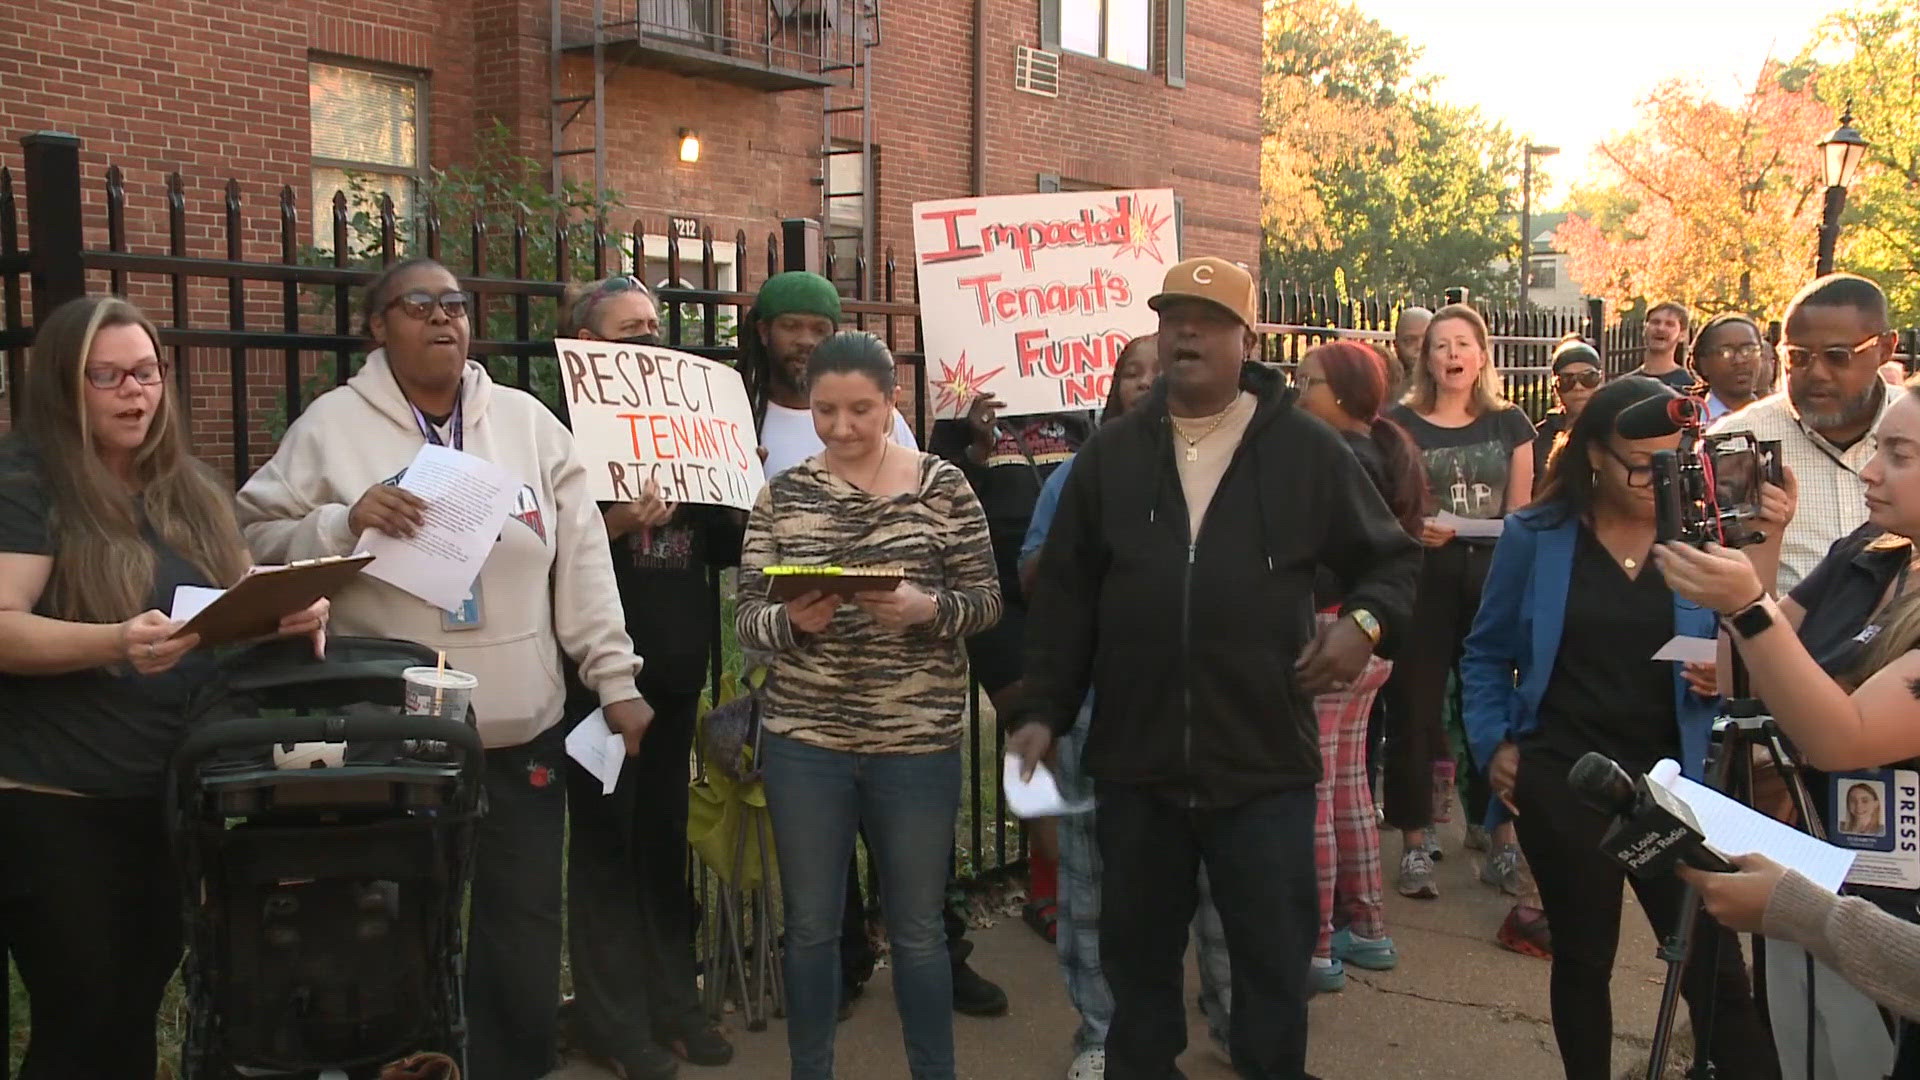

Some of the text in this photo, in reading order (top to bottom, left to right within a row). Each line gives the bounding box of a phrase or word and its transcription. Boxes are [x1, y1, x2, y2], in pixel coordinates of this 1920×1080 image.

[673, 218, 697, 236] 7212
[920, 196, 1132, 272] Impacted
[1192, 265, 1214, 285] C
[1015, 328, 1131, 378] FUND
[563, 350, 715, 414] RESPECT
[1060, 373, 1113, 407] NO
[616, 413, 748, 471] TENANTS
[1631, 831, 1660, 852] Louis
[1900, 786, 1916, 852] PRESS
[1628, 826, 1688, 868] Public Radio
